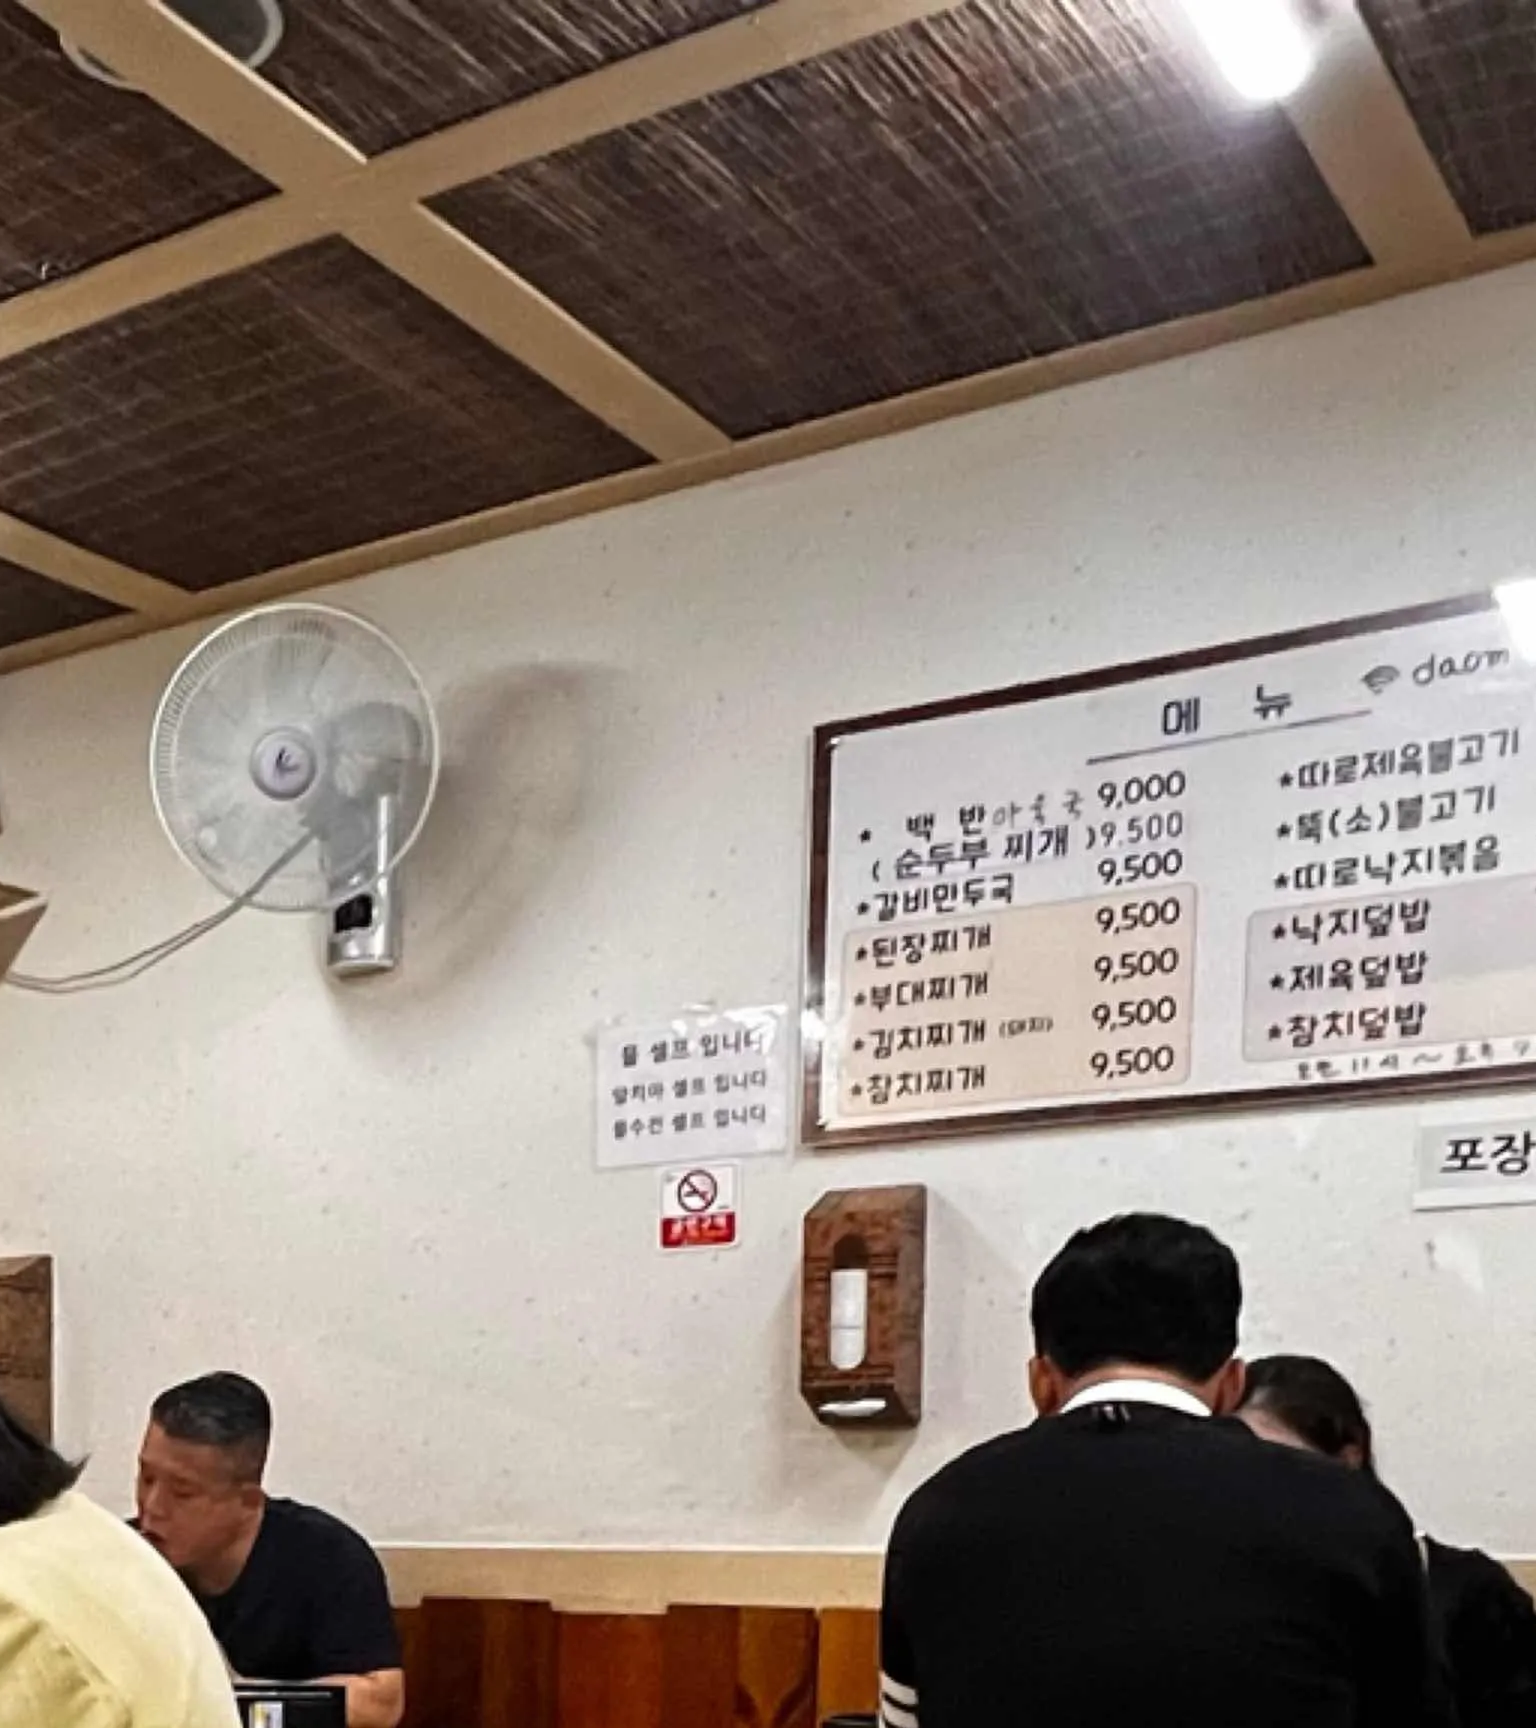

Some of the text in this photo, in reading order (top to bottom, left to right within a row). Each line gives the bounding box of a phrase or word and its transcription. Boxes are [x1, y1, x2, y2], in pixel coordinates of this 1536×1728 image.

[1298, 729, 1519, 790] 따로제육불고기
[1097, 770, 1185, 810] 9,000
[1097, 849, 1183, 886] 9,500
[872, 898, 1180, 967] 된장찌개 9,500
[1293, 899, 1429, 945] 낙지덮밥
[871, 948, 1178, 1011] 부대찌개 9,500
[1290, 951, 1428, 993] 제육덮밥
[869, 1019, 985, 1059] 김치찌개
[1092, 996, 1176, 1033] 9,500
[1288, 1003, 1426, 1047] 참치덮밥
[867, 1046, 1174, 1104] 참치찌개 9,500
